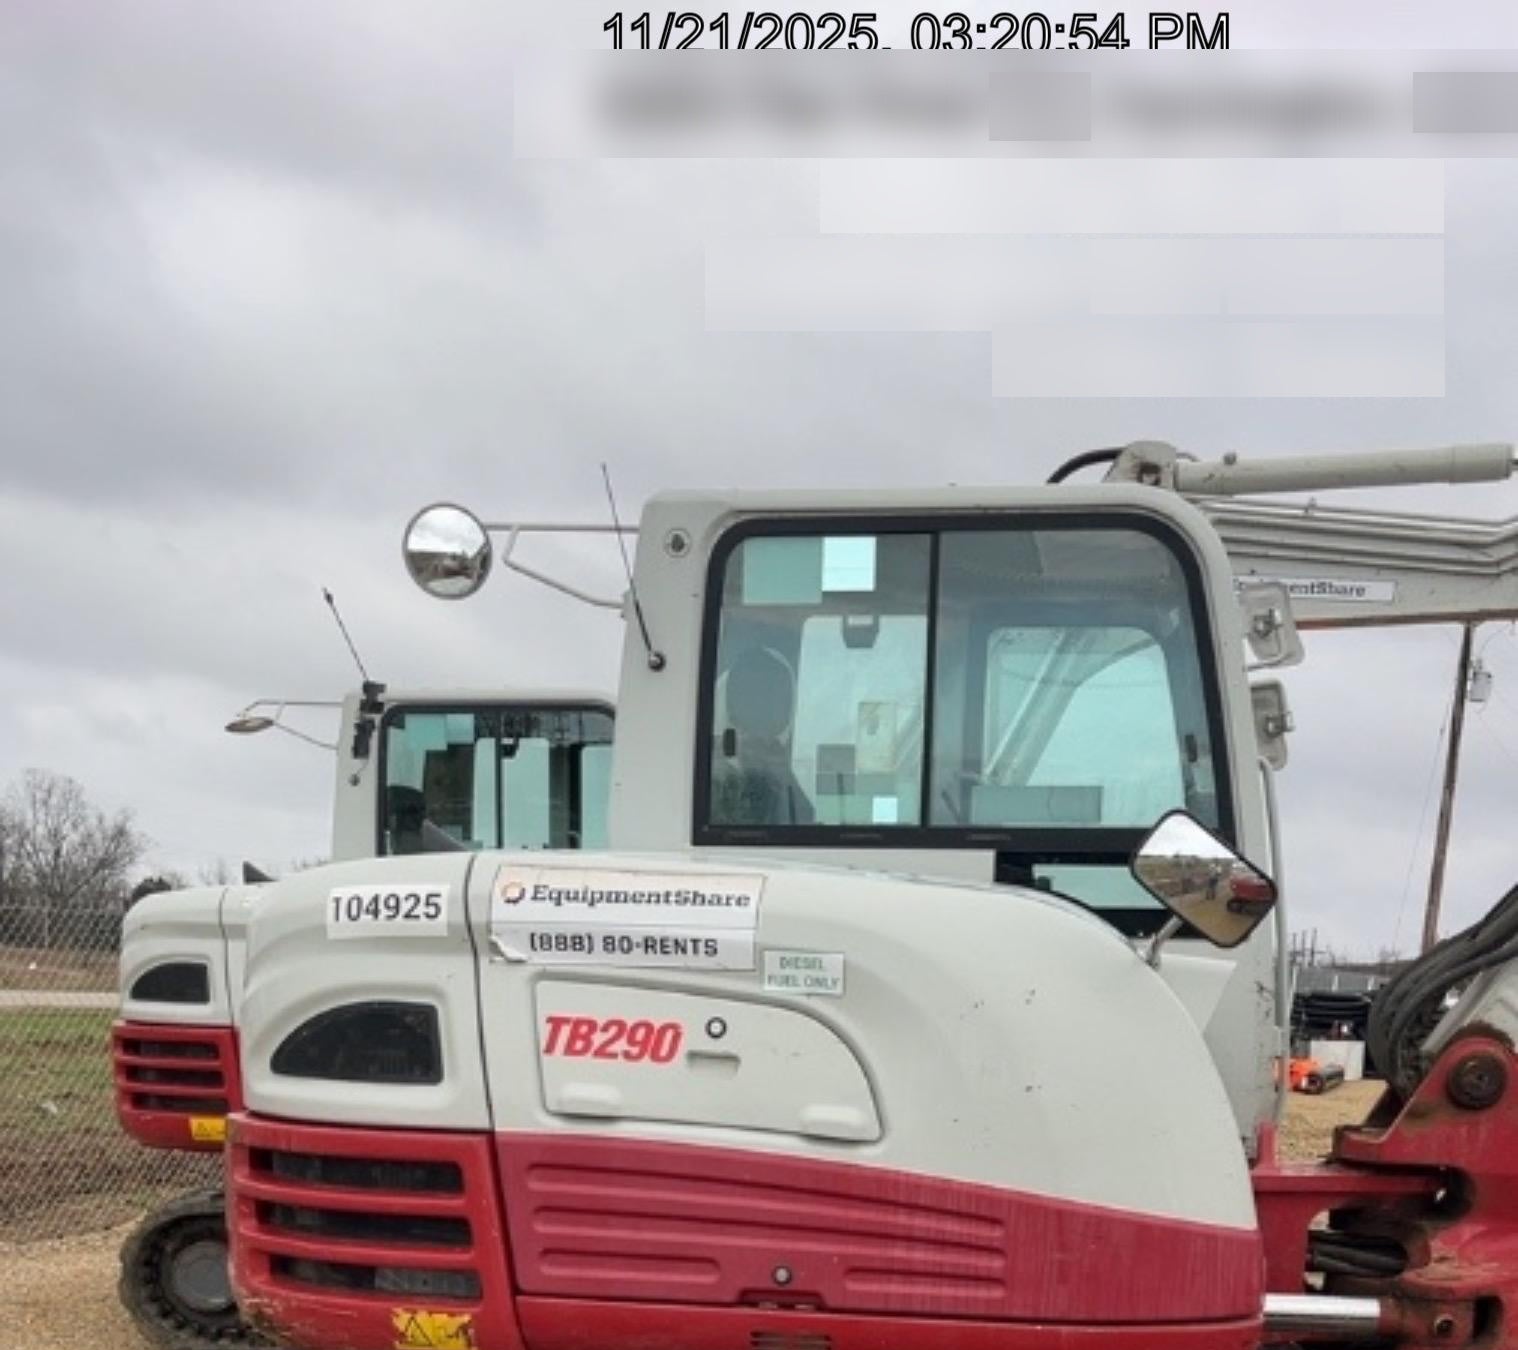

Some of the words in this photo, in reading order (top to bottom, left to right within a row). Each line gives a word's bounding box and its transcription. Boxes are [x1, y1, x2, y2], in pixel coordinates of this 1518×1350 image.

[333, 893, 442, 922] 104925
[531, 884, 751, 908] EquipmentShare
[530, 932, 594, 952] (888)
[543, 1016, 683, 1063] TB290
